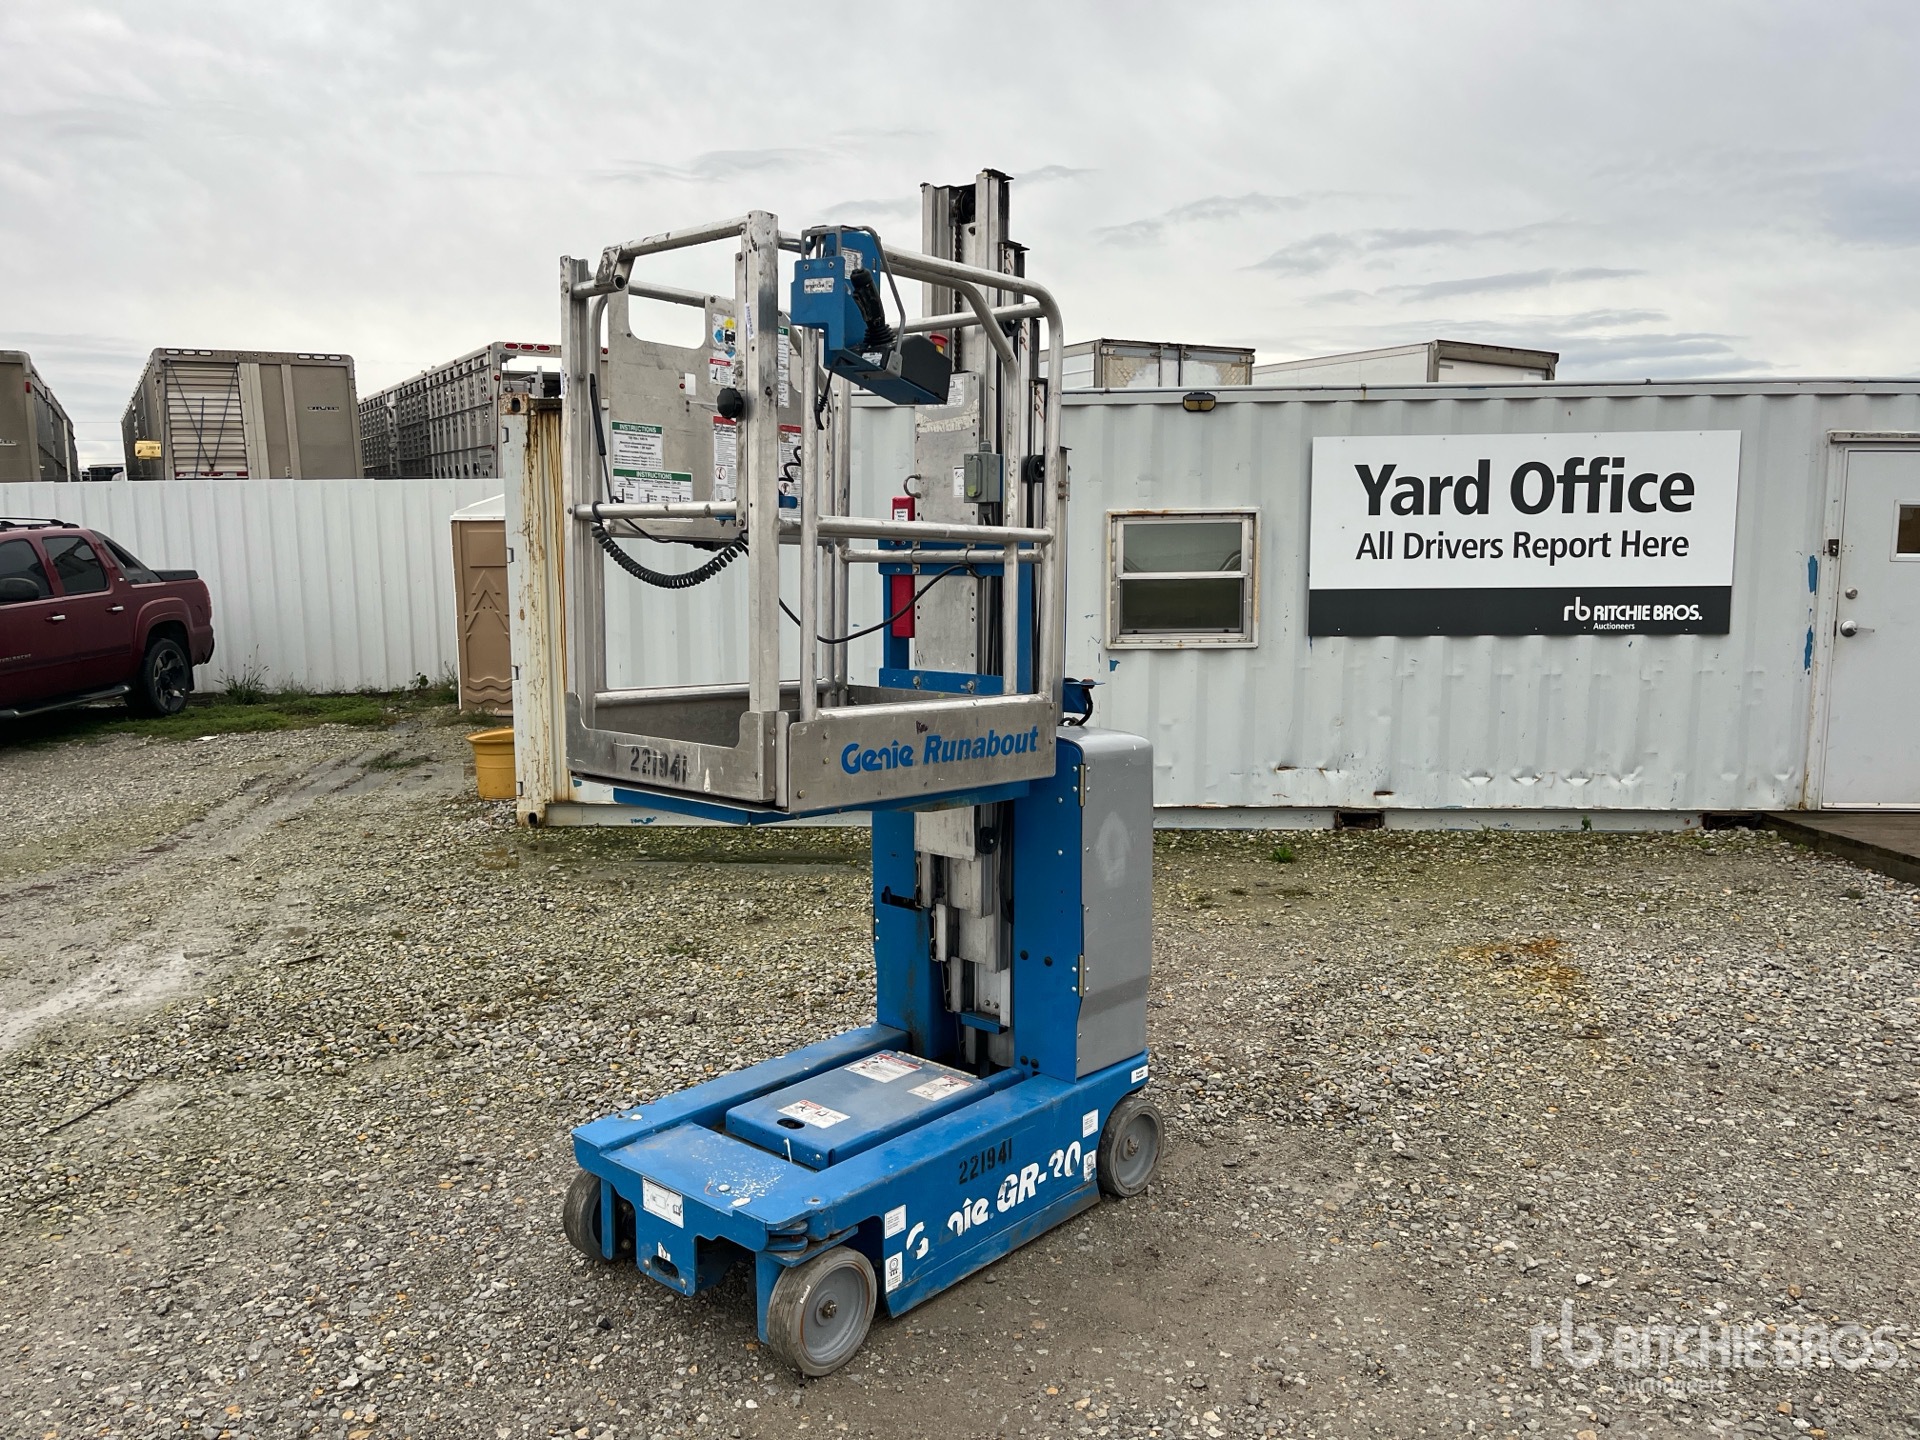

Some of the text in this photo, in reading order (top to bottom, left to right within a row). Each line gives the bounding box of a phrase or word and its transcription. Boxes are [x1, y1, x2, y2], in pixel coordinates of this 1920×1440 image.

[619, 424, 657, 433] INSTRUCTIONS
[636, 471, 672, 480] INSTRUCTIONS
[1354, 456, 1695, 516] Yard Office
[1356, 530, 1689, 566] All Drivers Report Here
[1563, 597, 1703, 621] rb RITCHIE BROS.
[1593, 622, 1635, 630] Auctioneers
[629, 747, 687, 783] 221941
[841, 725, 1040, 775] Genie Runabout
[958, 1138, 1013, 1185] 221941
[906, 1141, 1082, 1260] Gnie GR-20
